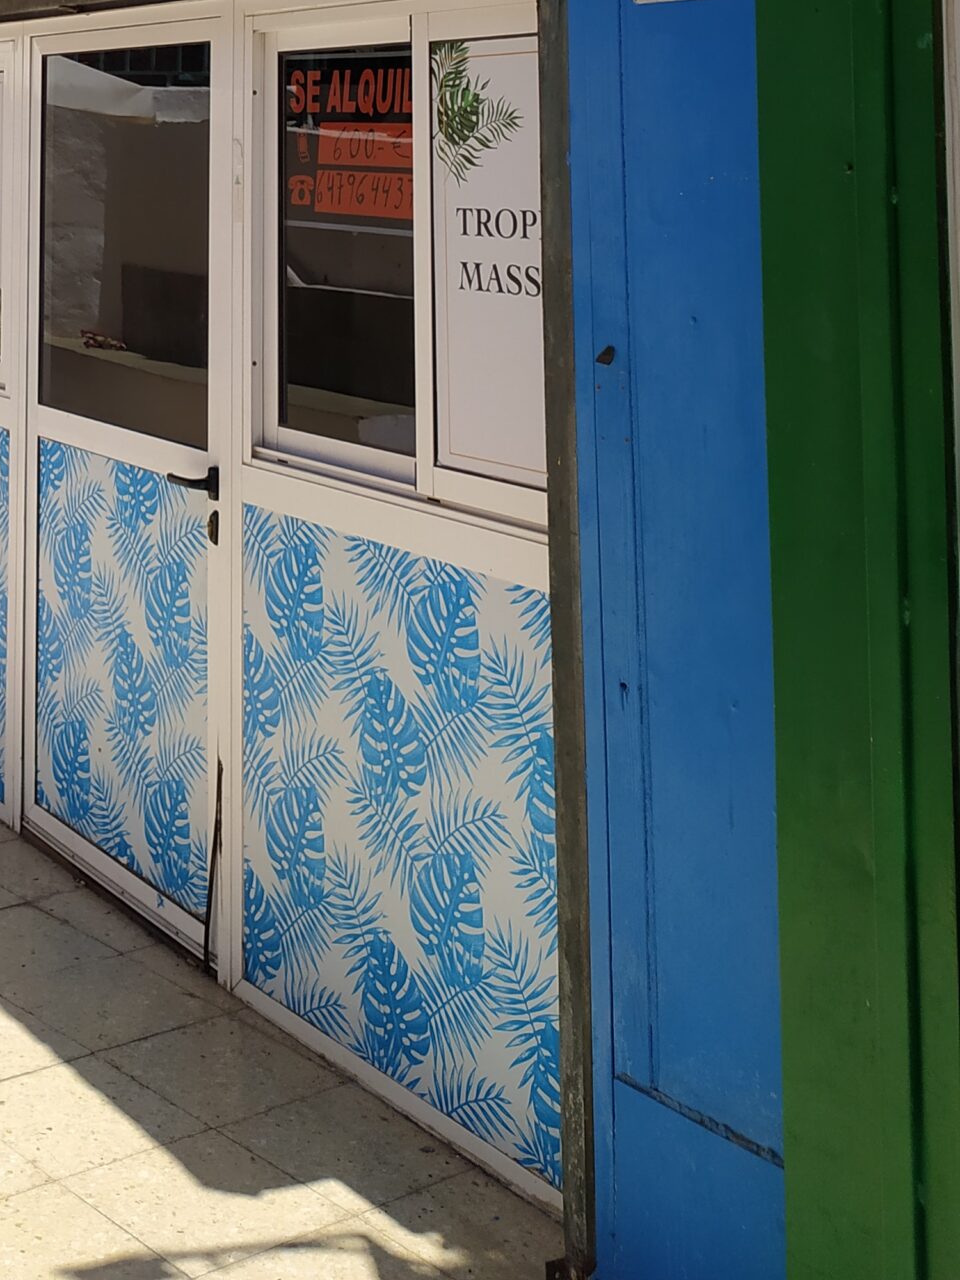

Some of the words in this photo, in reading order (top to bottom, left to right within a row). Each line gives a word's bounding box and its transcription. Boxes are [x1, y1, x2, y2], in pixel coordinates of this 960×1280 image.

[290, 70, 321, 114] SE
[326, 68, 413, 117] ALQUIL
[456, 207, 542, 240] TROP
[458, 261, 541, 297] MASS
